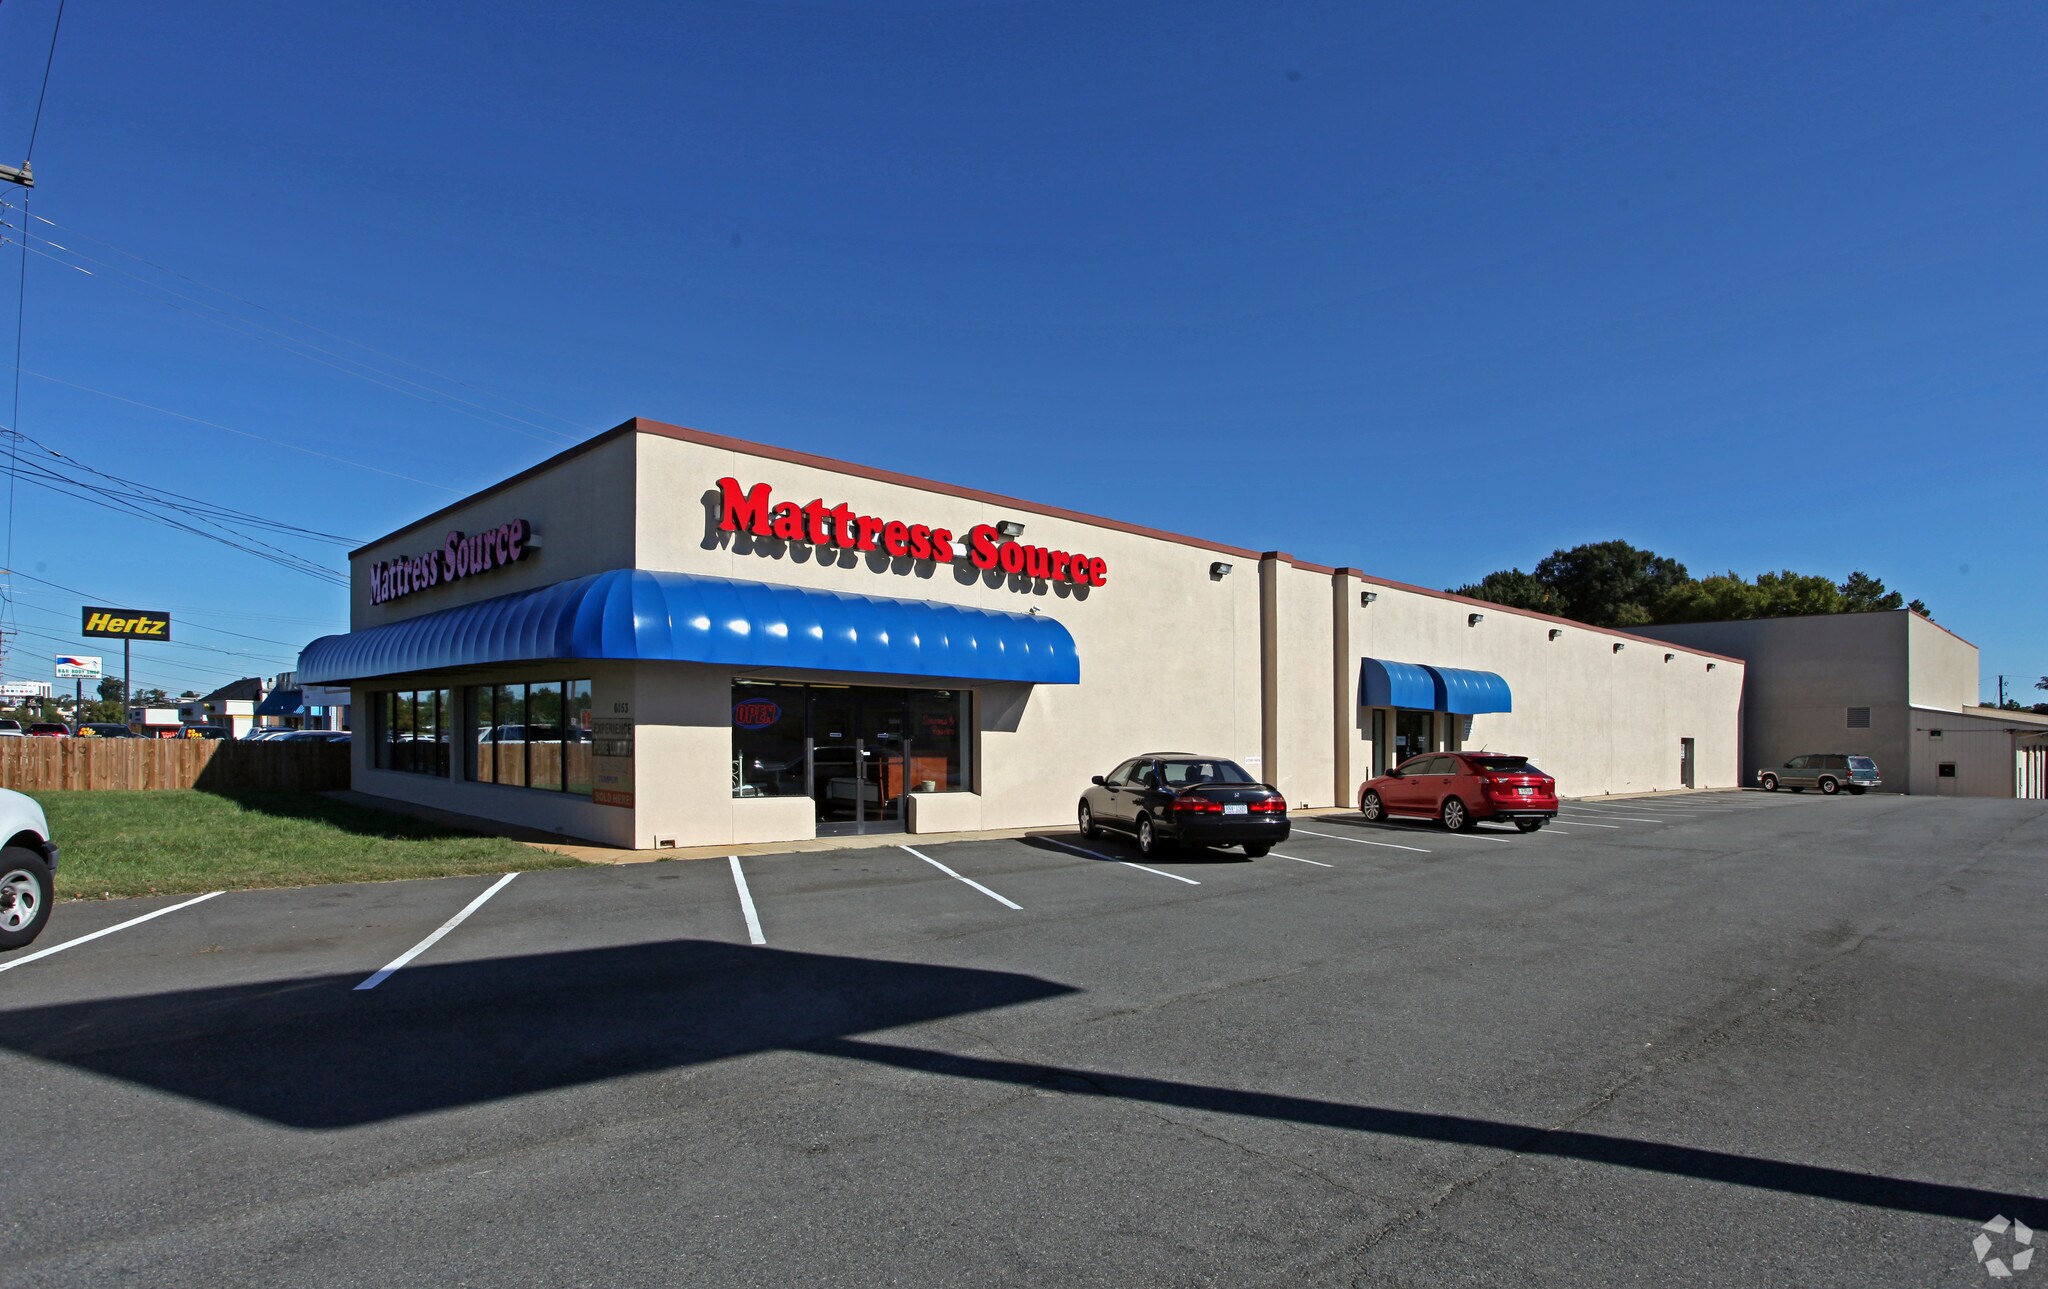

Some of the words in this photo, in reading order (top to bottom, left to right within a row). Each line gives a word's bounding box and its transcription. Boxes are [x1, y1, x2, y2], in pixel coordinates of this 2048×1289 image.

[717, 477, 953, 562] Mattress
[970, 524, 1107, 587] Source
[370, 560, 438, 605] Mattress
[444, 519, 523, 582] Source
[86, 612, 167, 635] Hertz
[614, 703, 628, 713] 6153
[736, 704, 776, 723] OPEN
[594, 791, 612, 803] SOLD
